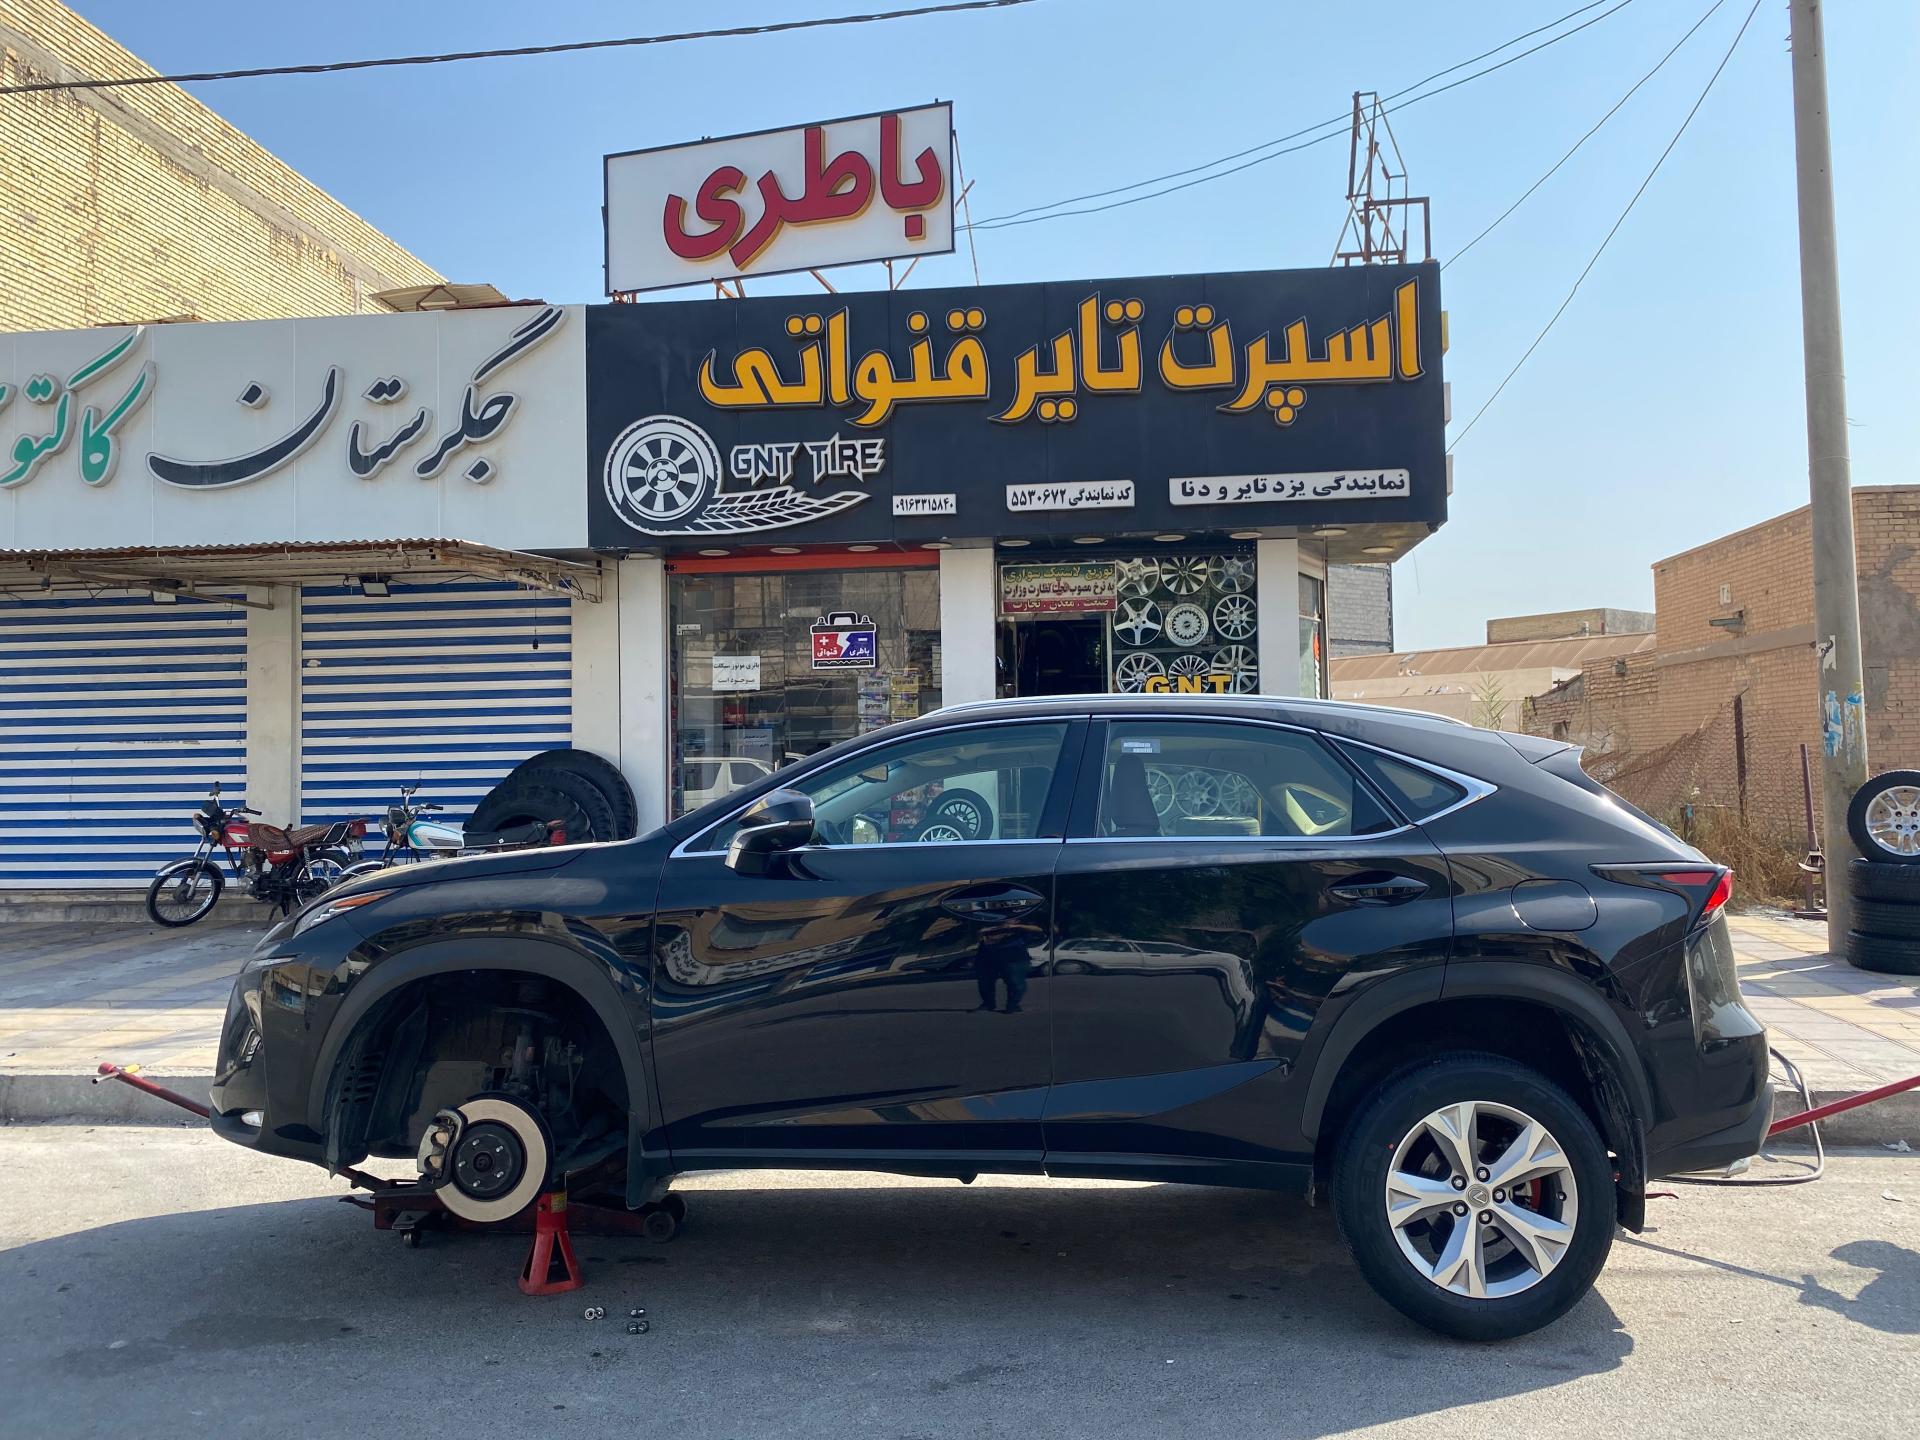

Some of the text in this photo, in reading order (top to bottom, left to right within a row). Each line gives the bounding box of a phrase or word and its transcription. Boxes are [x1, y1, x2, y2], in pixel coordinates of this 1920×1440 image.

[663, 114, 945, 271] باطری
[698, 276, 1425, 428] اسپرت تایر قنواتی
[0, 325, 157, 489] کاکتو
[730, 432, 886, 486] GNT TIRE
[1011, 486, 1131, 506] کد نمایندگی ۵۵۳۰۶۷۲
[1181, 473, 1405, 500] نمایندگی یزد تایر و دنا
[1044, 564, 1080, 578] لاستیک
[1004, 583, 1027, 597] وزارت
[1093, 581, 1106, 595] نرخ
[1108, 582, 1115, 594] به
[849, 647, 870, 656] باطری
[1145, 674, 1232, 694] GNT
